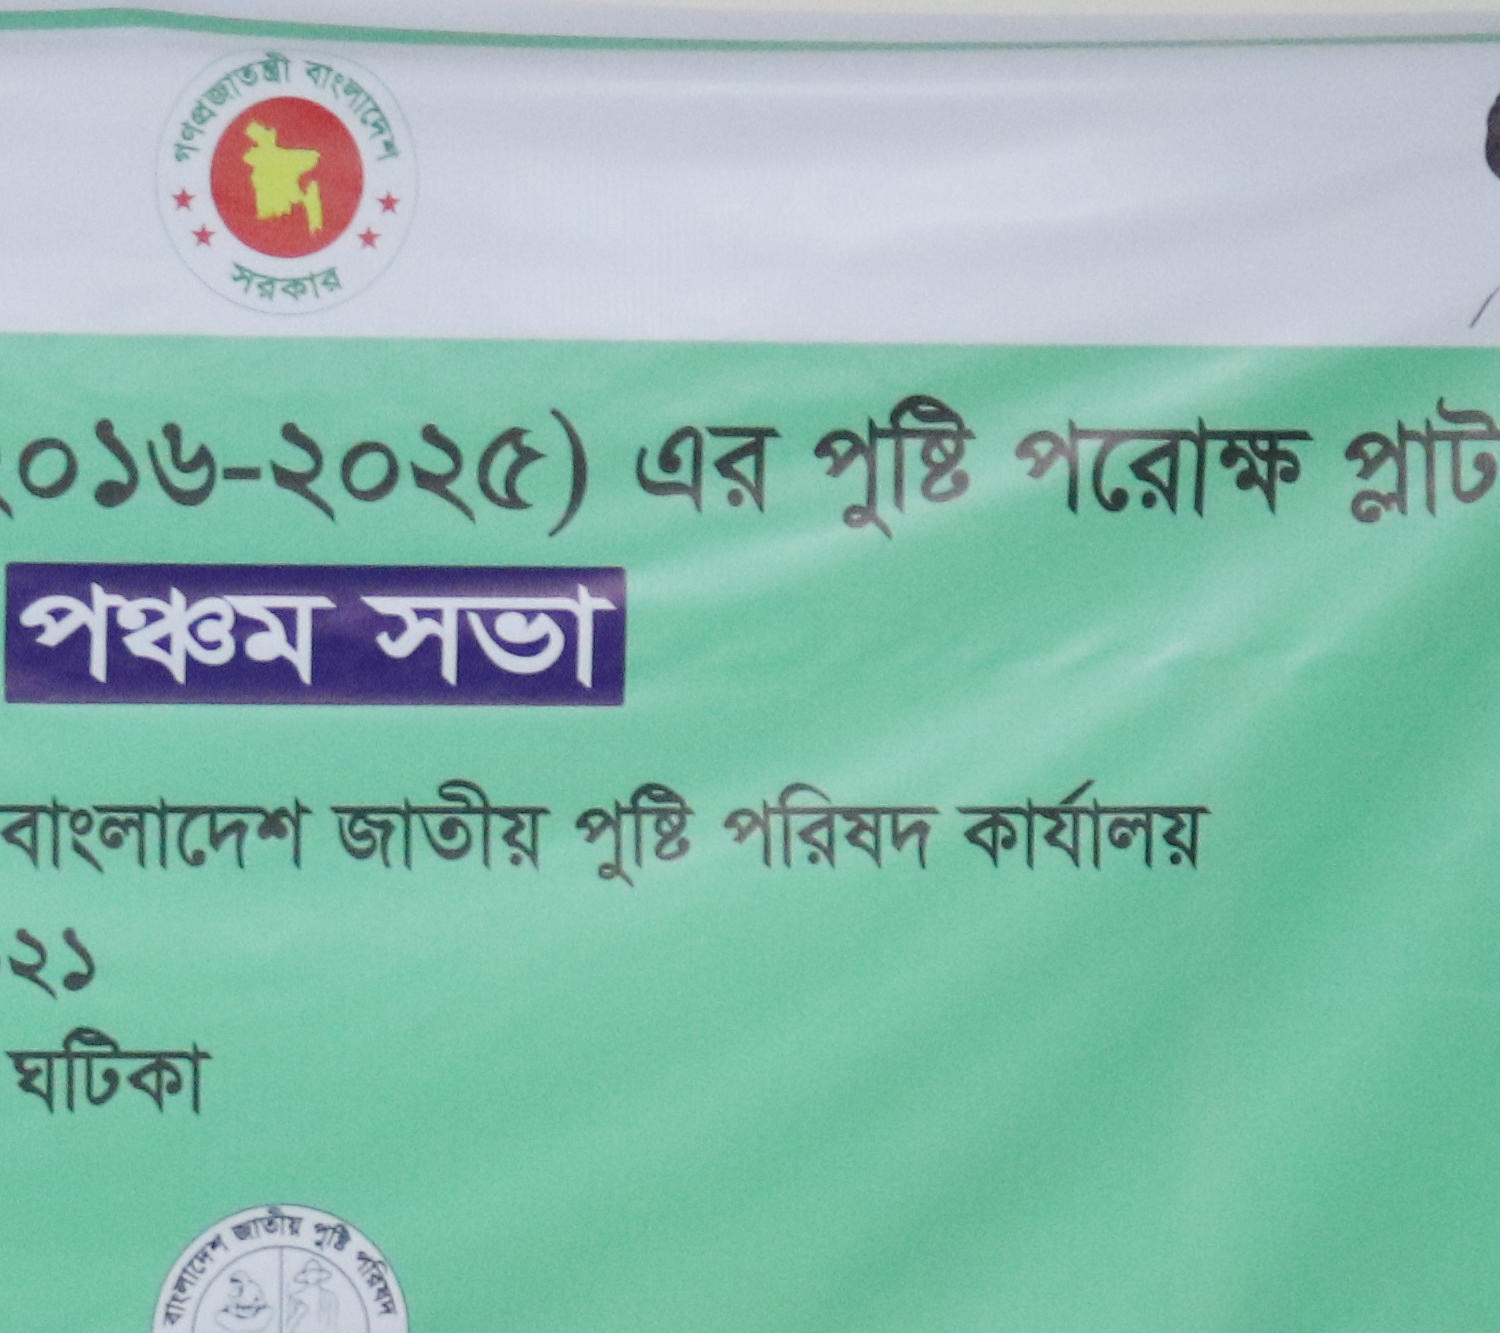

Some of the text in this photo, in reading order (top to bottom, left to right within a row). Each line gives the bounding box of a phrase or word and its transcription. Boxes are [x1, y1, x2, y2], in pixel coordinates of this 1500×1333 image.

[305, 60, 399, 161] বাংলাদেশ
[231, 262, 342, 300] সরকার
[635, 426, 781, 514] এর
[814, 394, 976, 538] পুষ্টি
[1016, 417, 1313, 517] পরোক্ষ
[20, 582, 617, 688] পঞ্চম সভা
[330, 779, 550, 869] জাতীয়
[575, 782, 696, 887] পুষ্টি
[724, 782, 939, 869] পরিষদ
[957, 779, 1211, 869] কার্যালয়
[6, 1026, 213, 1113] ঘটিকা
